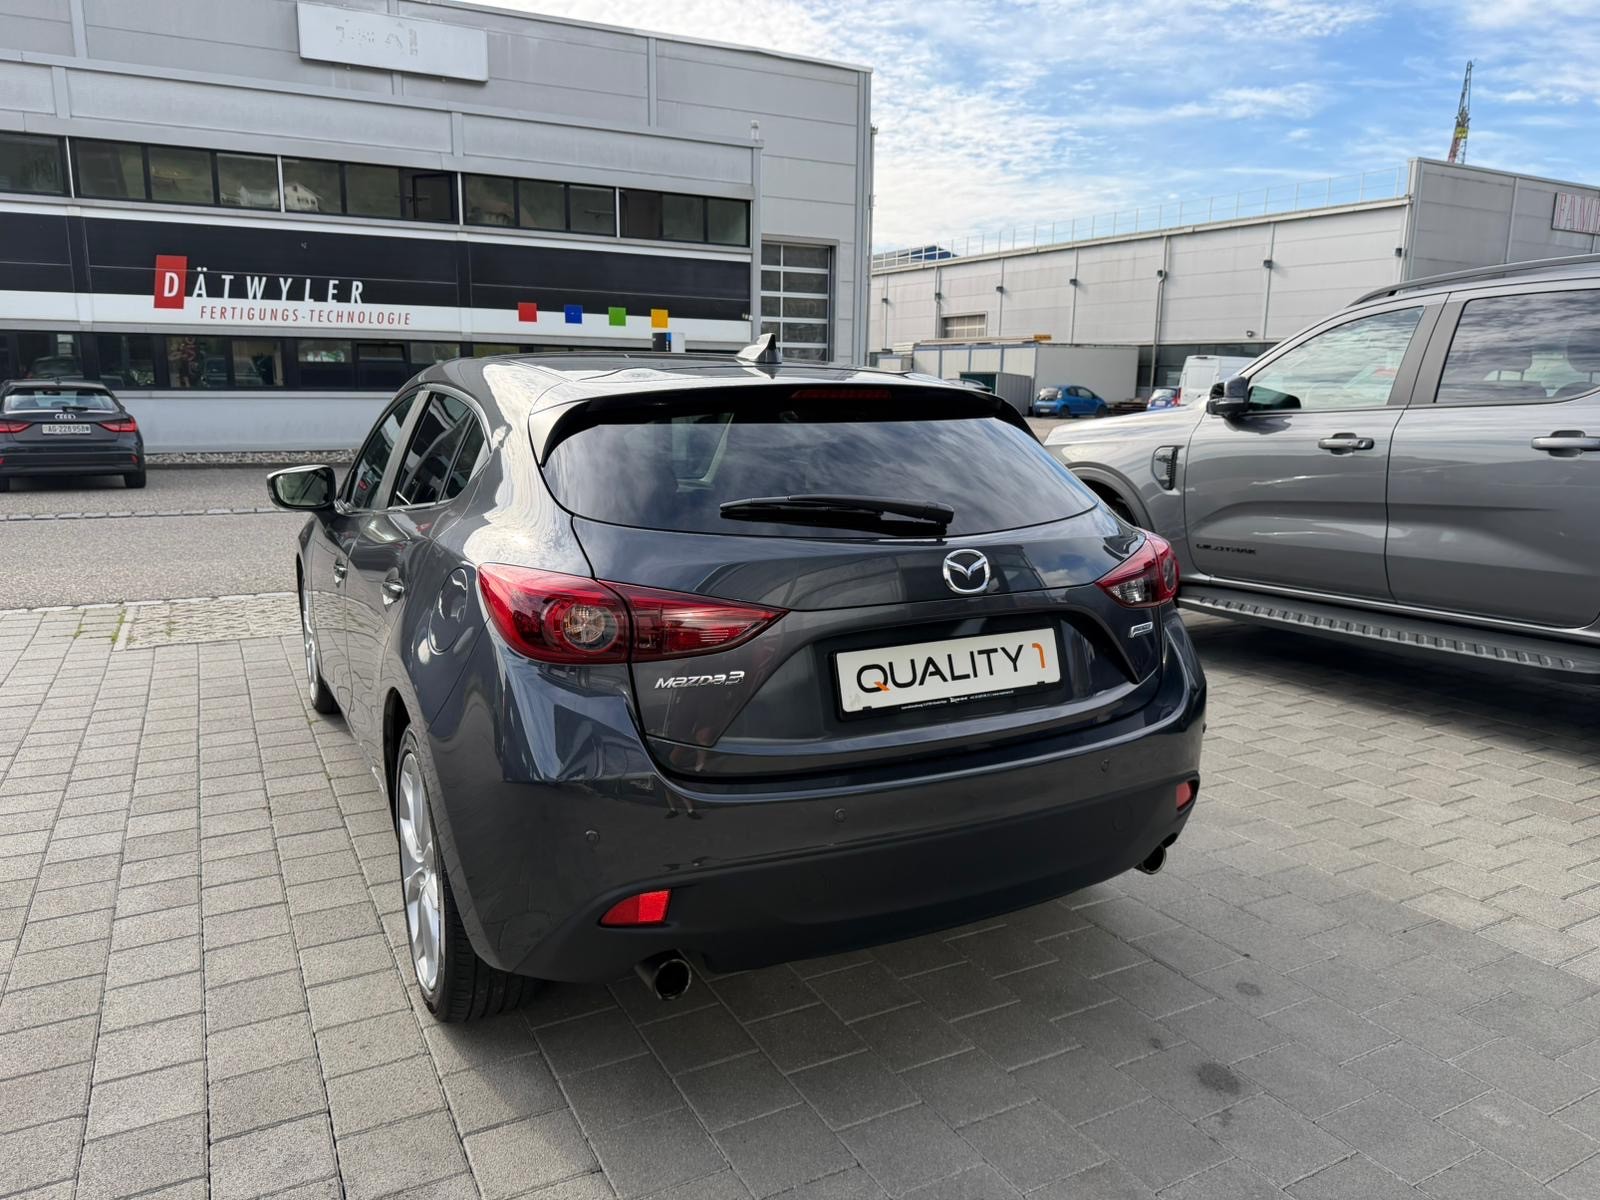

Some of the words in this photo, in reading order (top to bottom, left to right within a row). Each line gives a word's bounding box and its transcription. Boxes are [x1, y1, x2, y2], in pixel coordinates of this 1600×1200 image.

[163, 266, 364, 304] DÄTWYLER
[200, 305, 411, 326] FERTIGUNGS-TECHNOLOGIE
[856, 644, 1024, 694] QUALITY
[1031, 642, 1046, 669] 1
